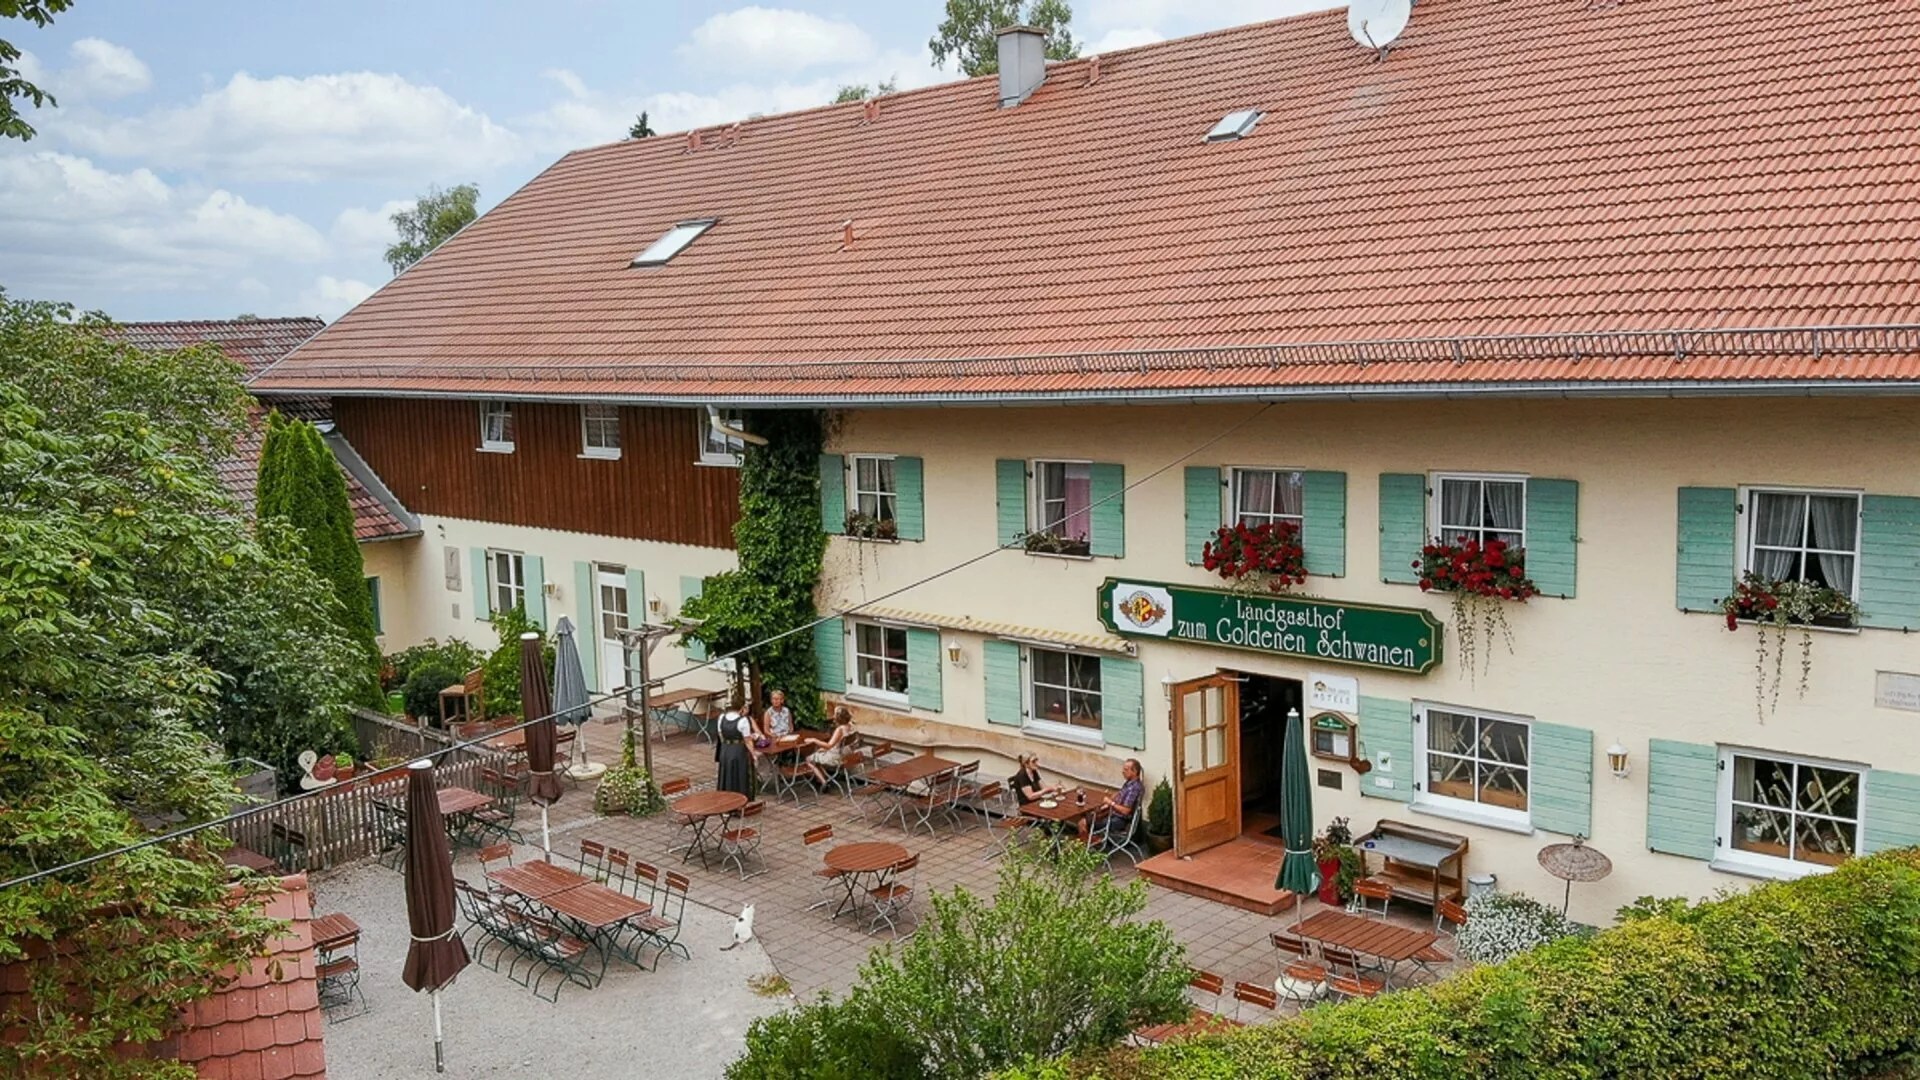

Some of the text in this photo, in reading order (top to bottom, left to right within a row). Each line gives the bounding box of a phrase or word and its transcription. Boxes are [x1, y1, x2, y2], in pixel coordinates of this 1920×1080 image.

[1236, 599, 1345, 632] Landgasthof
[1177, 617, 1415, 667] zum Goldenen Schwanen
